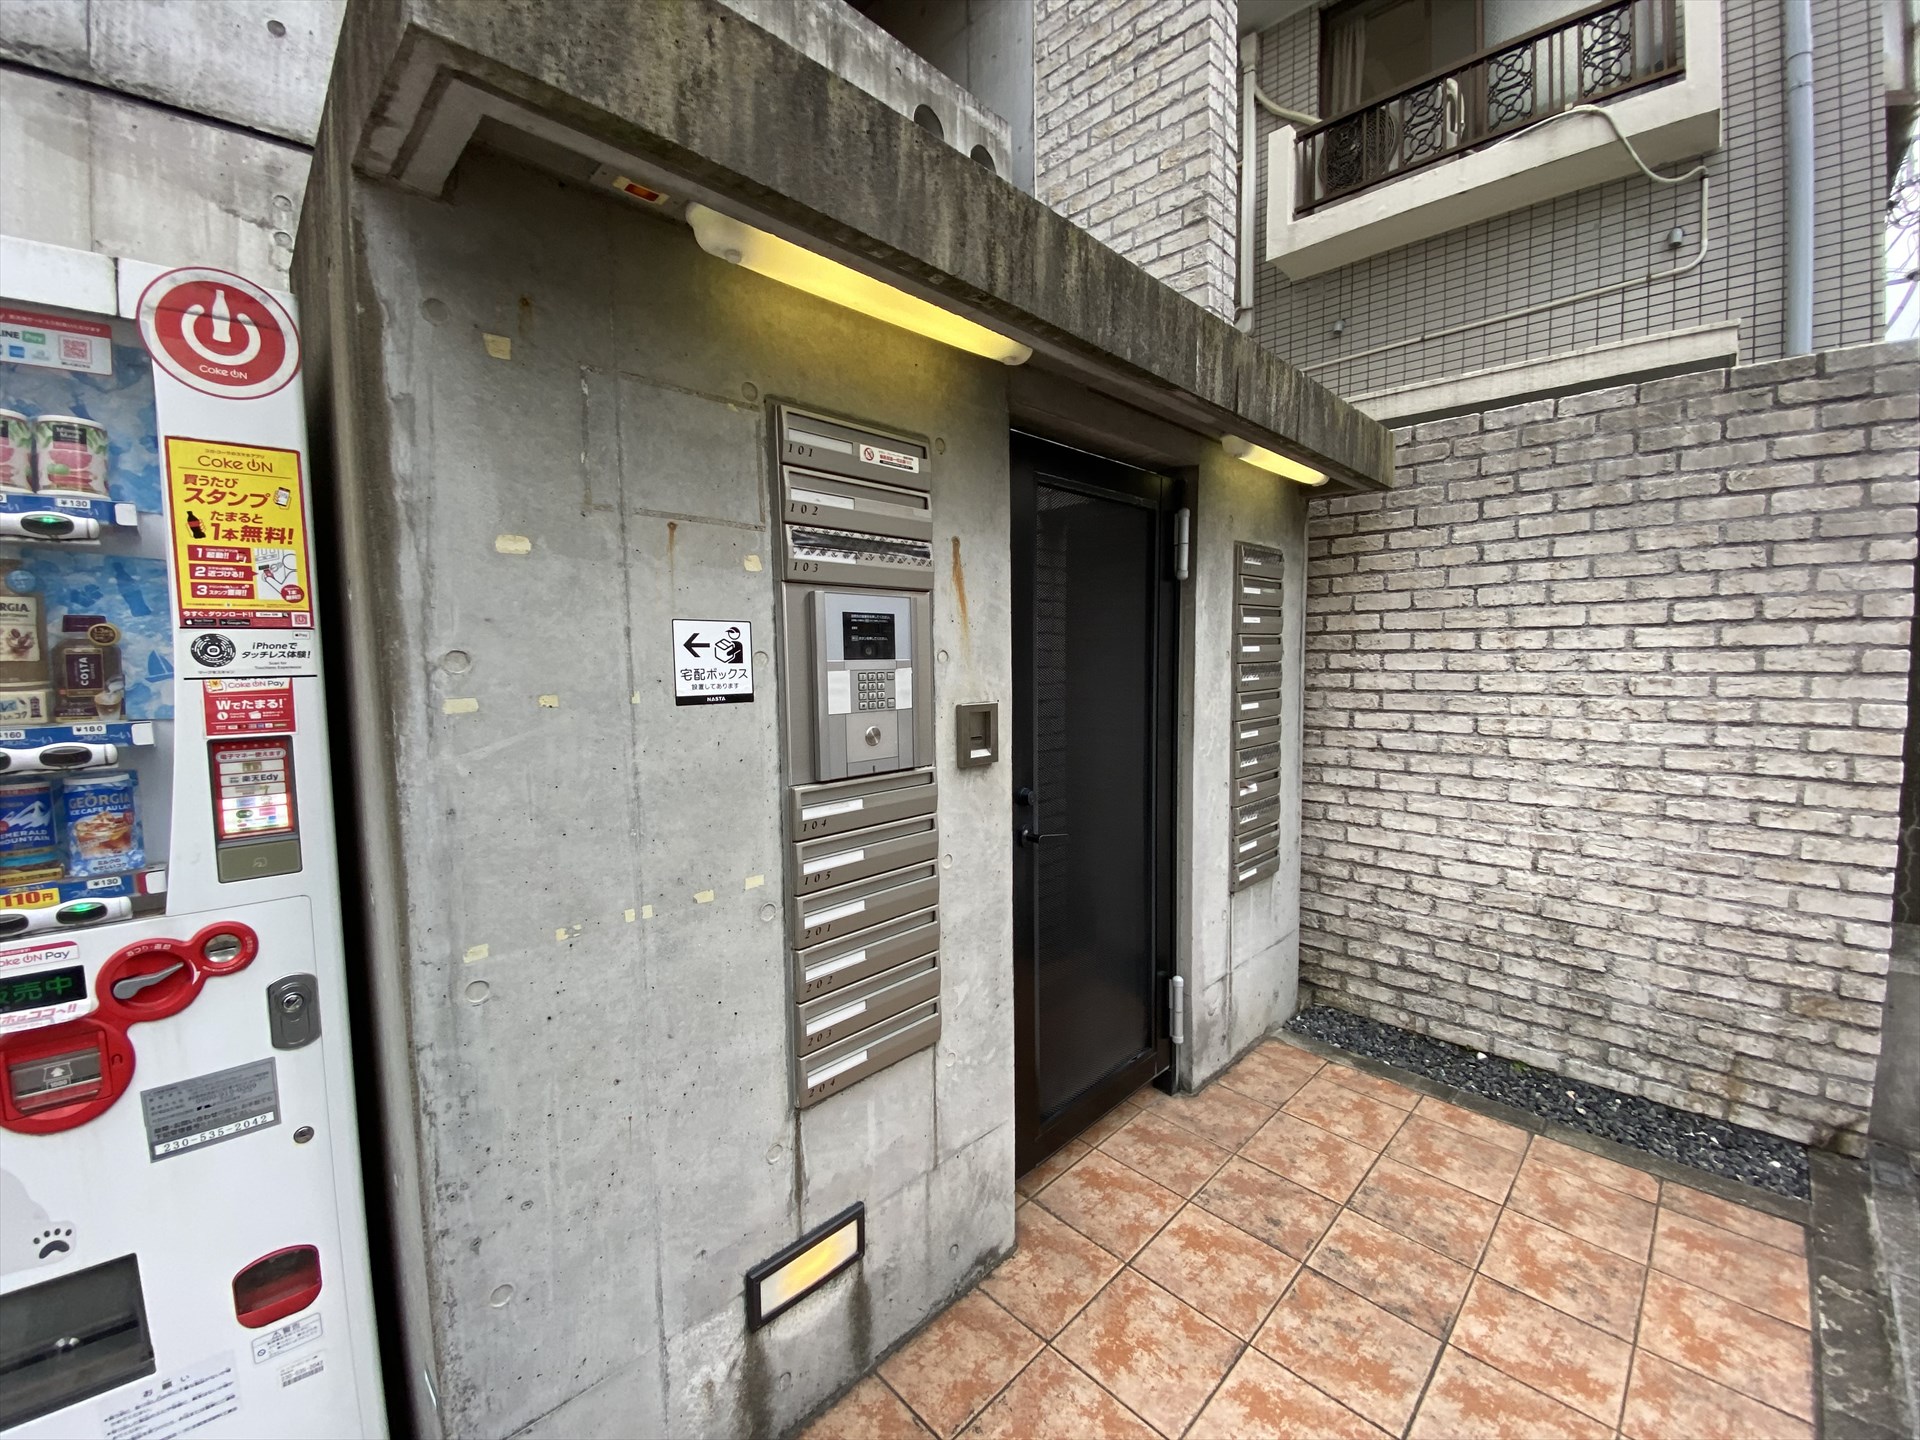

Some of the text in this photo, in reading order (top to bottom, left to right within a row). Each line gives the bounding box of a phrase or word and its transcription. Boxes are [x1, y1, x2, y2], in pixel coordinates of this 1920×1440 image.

[199, 364, 229, 377] Coke
[788, 443, 813, 457] 101
[197, 455, 244, 470] Coke
[183, 473, 239, 489] 買うたび
[184, 487, 271, 508] スタンプ
[790, 503, 818, 516] 102
[210, 510, 264, 524] たまると
[194, 566, 206, 577] 2
[793, 561, 819, 573] 103
[196, 585, 208, 596] 3
[252, 642, 298, 650] iPhoneで
[241, 650, 312, 659] タッチレス体験!
[79, 657, 89, 686] COSTA
[680, 668, 748, 681] 宅配ボックス
[227, 681, 251, 690] Coke
[267, 679, 285, 688] Pay
[691, 682, 739, 690] 設置してあります
[216, 698, 283, 710] Wでたまる!
[0, 731, 21, 739] 160
[241, 773, 279, 782] 楽天Edy
[802, 819, 827, 832] 104
[804, 871, 831, 885] 105
[0, 891, 54, 906] 110円
[804, 924, 831, 939] 201
[45, 951, 70, 961] Pay
[806, 975, 833, 993] 202
[807, 1029, 832, 1047] 203
[808, 1078, 835, 1098] 204
[163, 1115, 268, 1153] 230-535-2042
